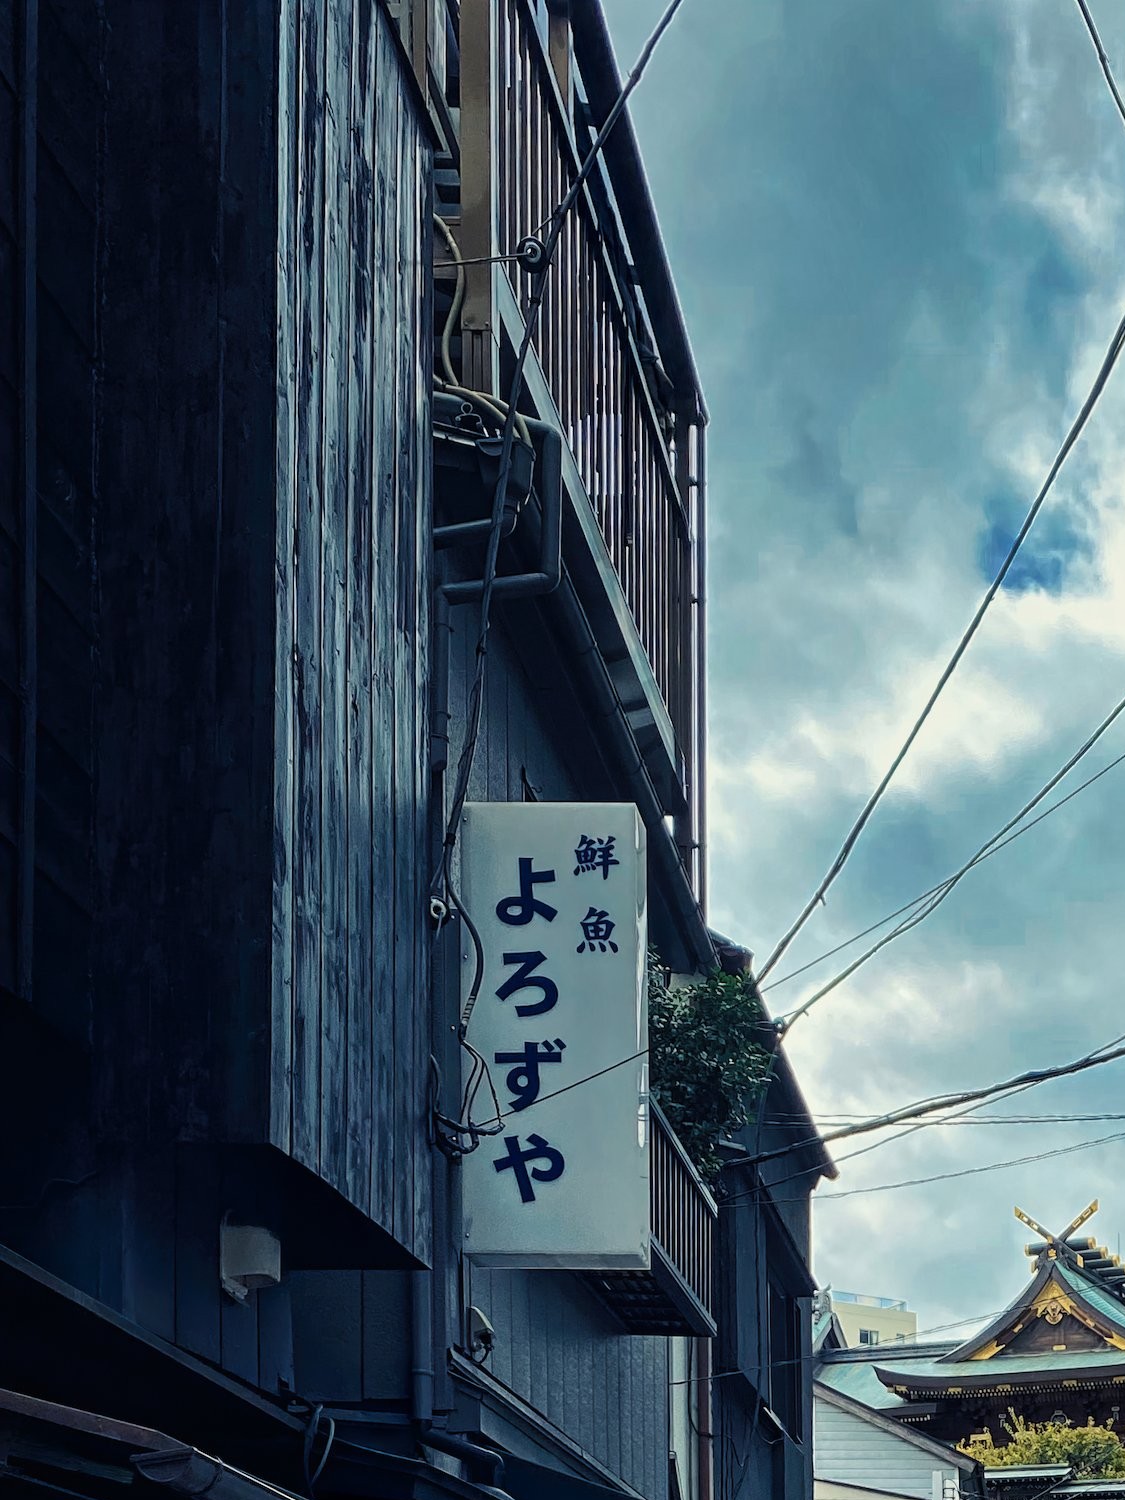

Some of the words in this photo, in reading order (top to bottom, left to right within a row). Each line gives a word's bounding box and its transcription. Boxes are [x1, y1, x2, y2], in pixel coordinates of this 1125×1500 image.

[573, 834, 621, 954] 鮮魚
[493, 857, 567, 1204] よろずや
